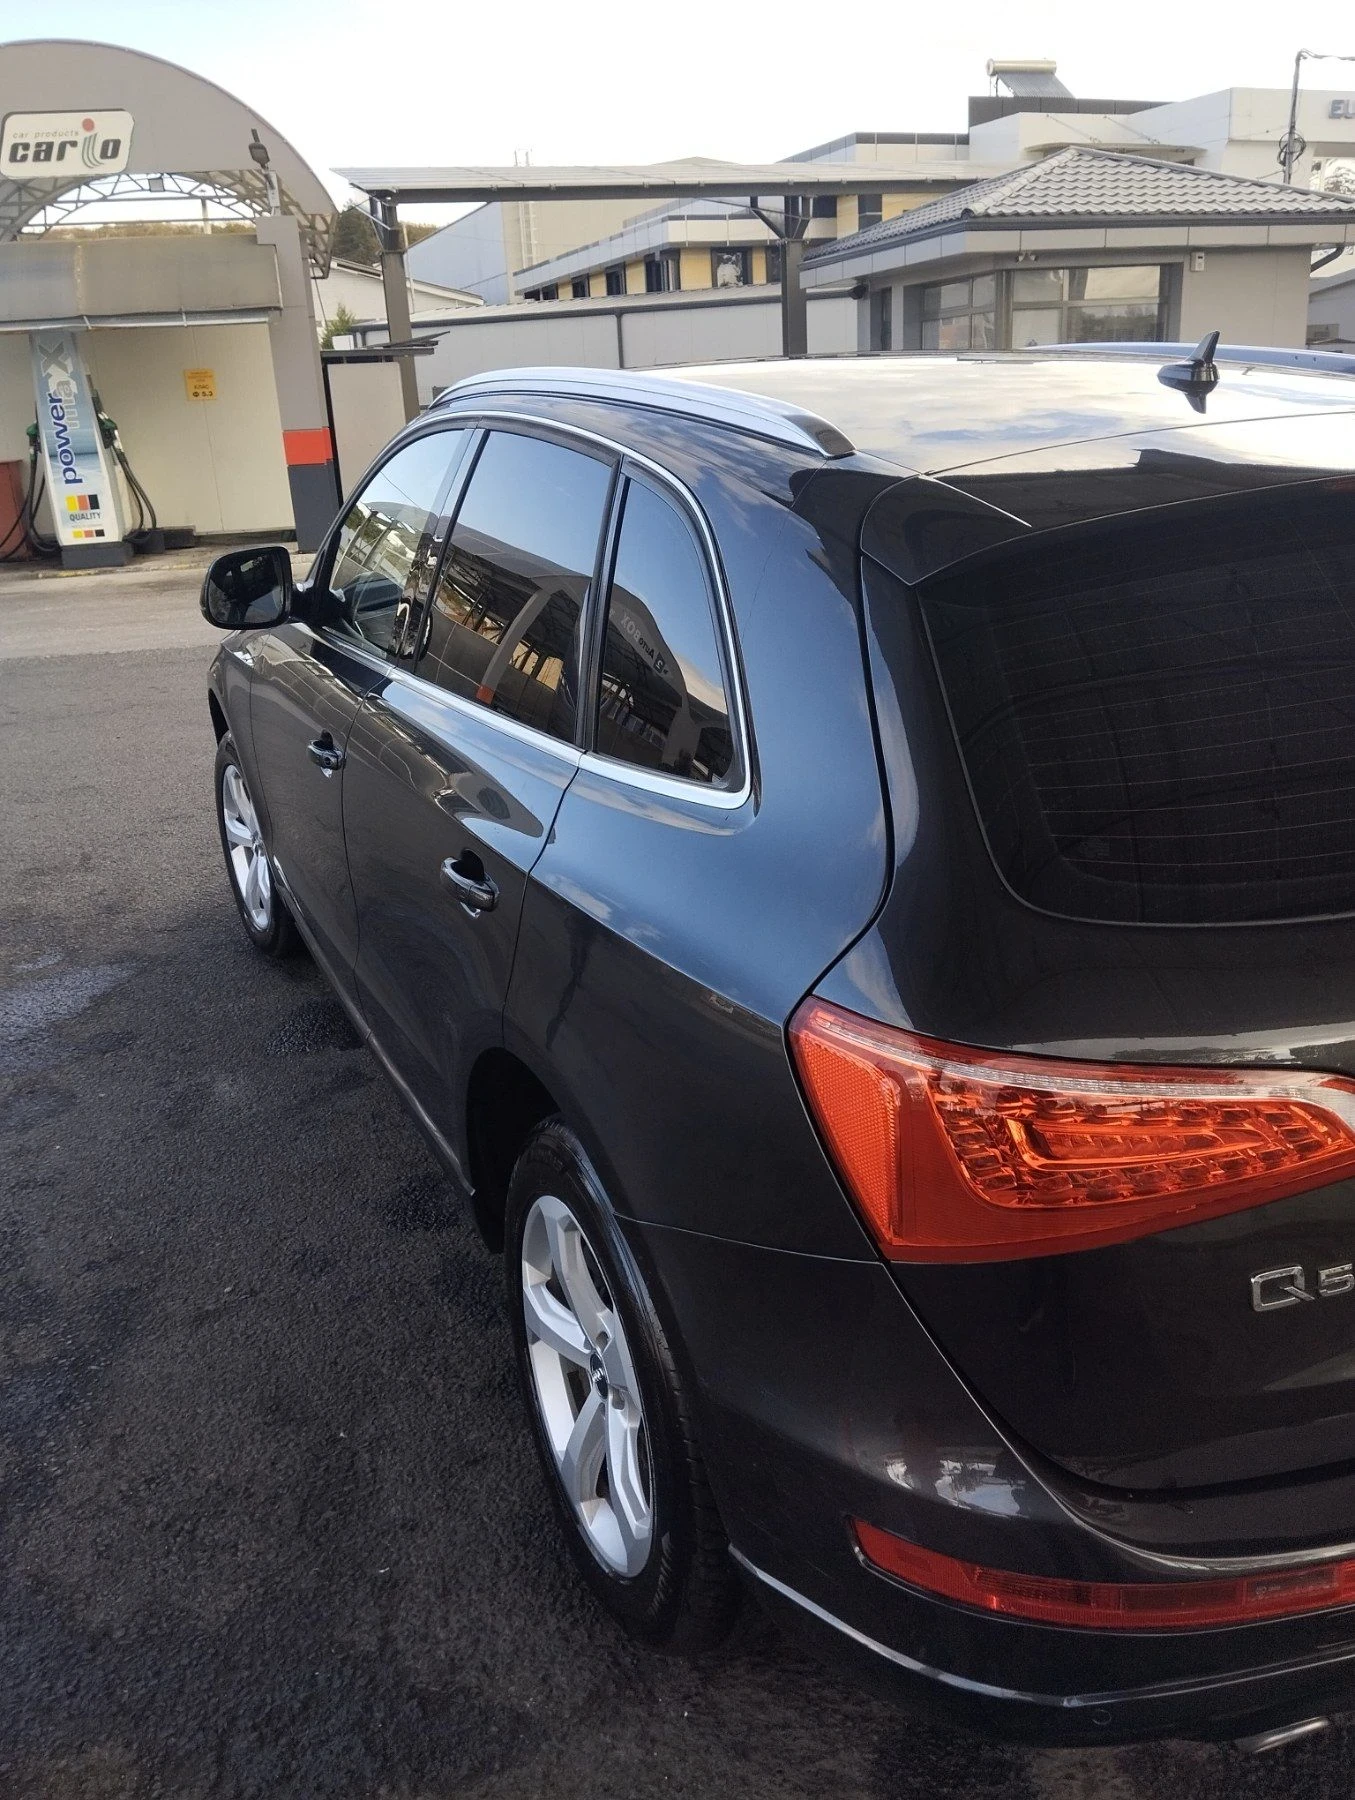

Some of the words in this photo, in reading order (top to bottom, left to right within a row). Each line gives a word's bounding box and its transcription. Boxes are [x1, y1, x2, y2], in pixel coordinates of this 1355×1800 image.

[13, 131, 29, 139] car
[34, 129, 79, 139] products
[47, 392, 83, 485] power
[69, 512, 101, 522] QUALITY
[1250, 1264, 1355, 1312] Q5
